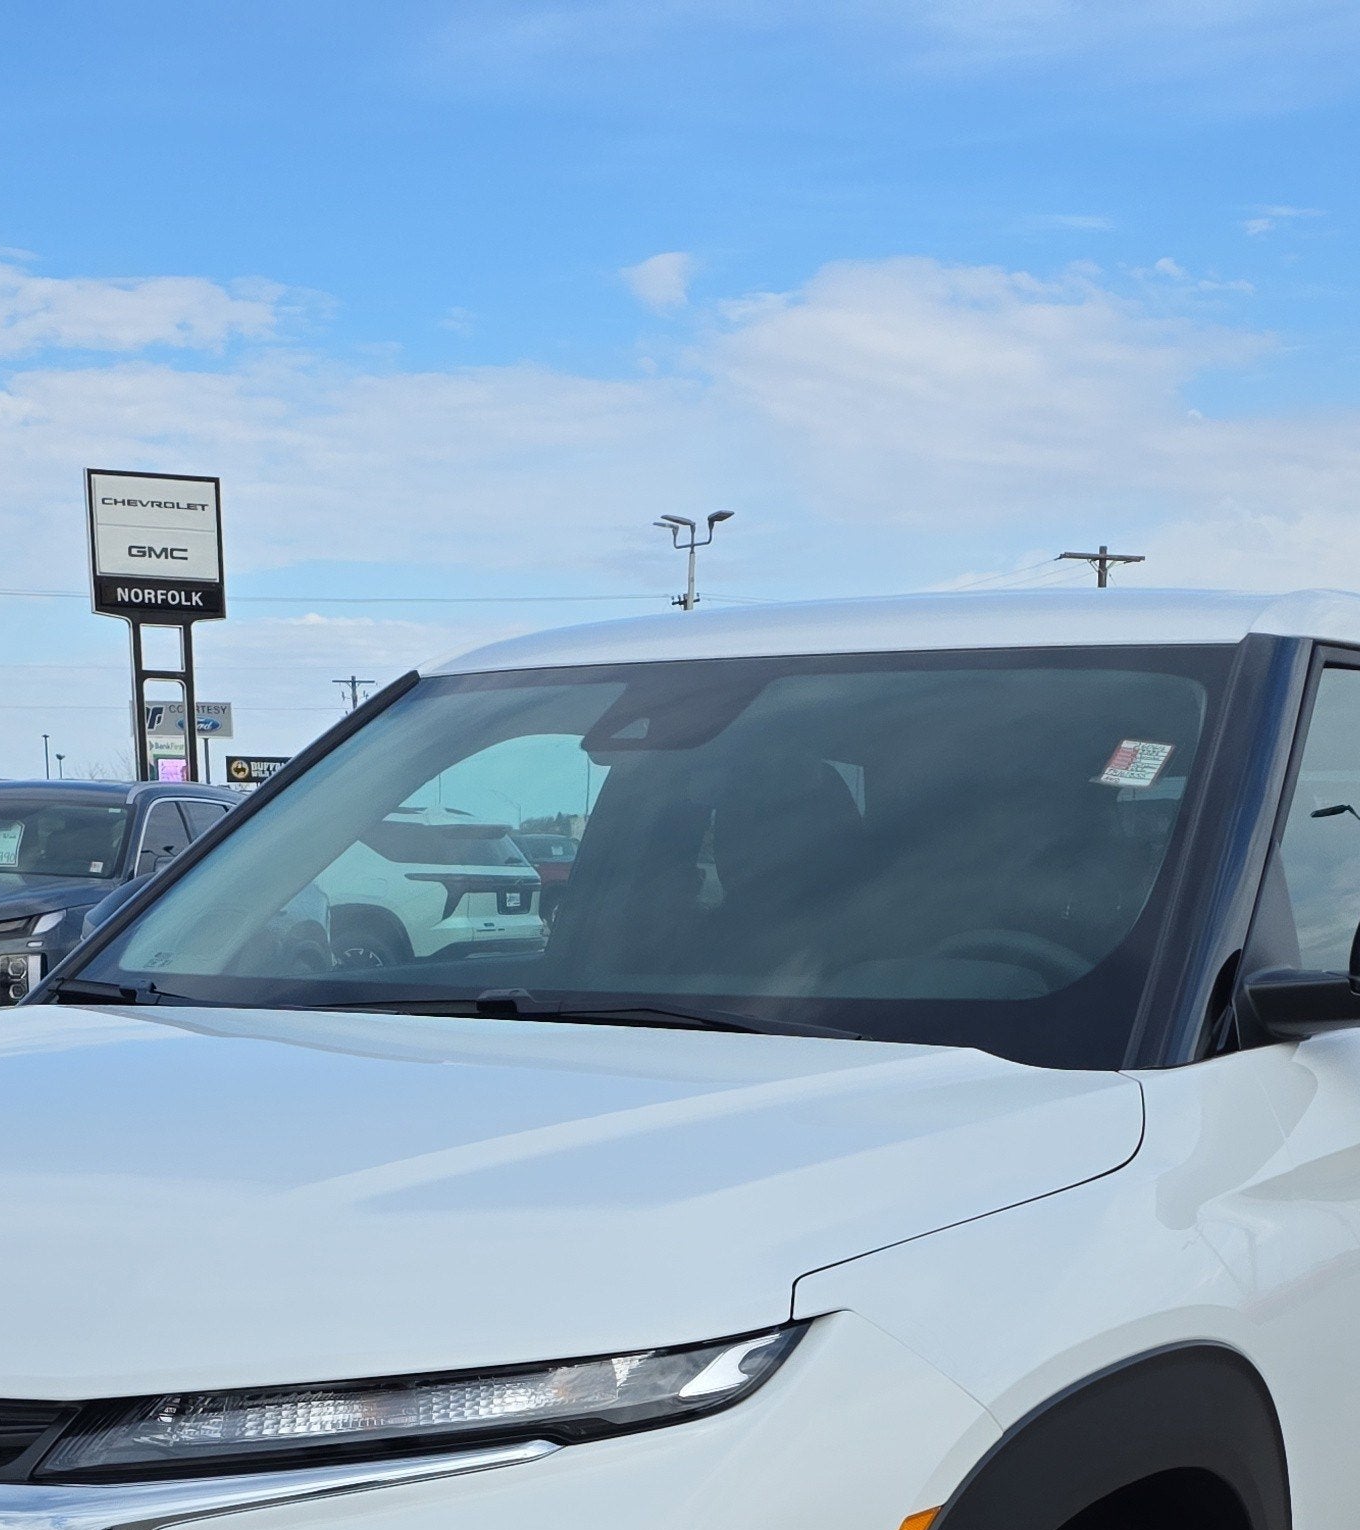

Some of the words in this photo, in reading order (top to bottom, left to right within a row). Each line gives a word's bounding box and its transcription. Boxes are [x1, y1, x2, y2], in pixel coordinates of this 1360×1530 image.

[101, 497, 209, 512] CHEVROLET
[127, 545, 189, 560] GMC
[116, 587, 204, 607] NORFOLK
[168, 704, 228, 715] CORTESY
[250, 761, 286, 772] BUFFA
